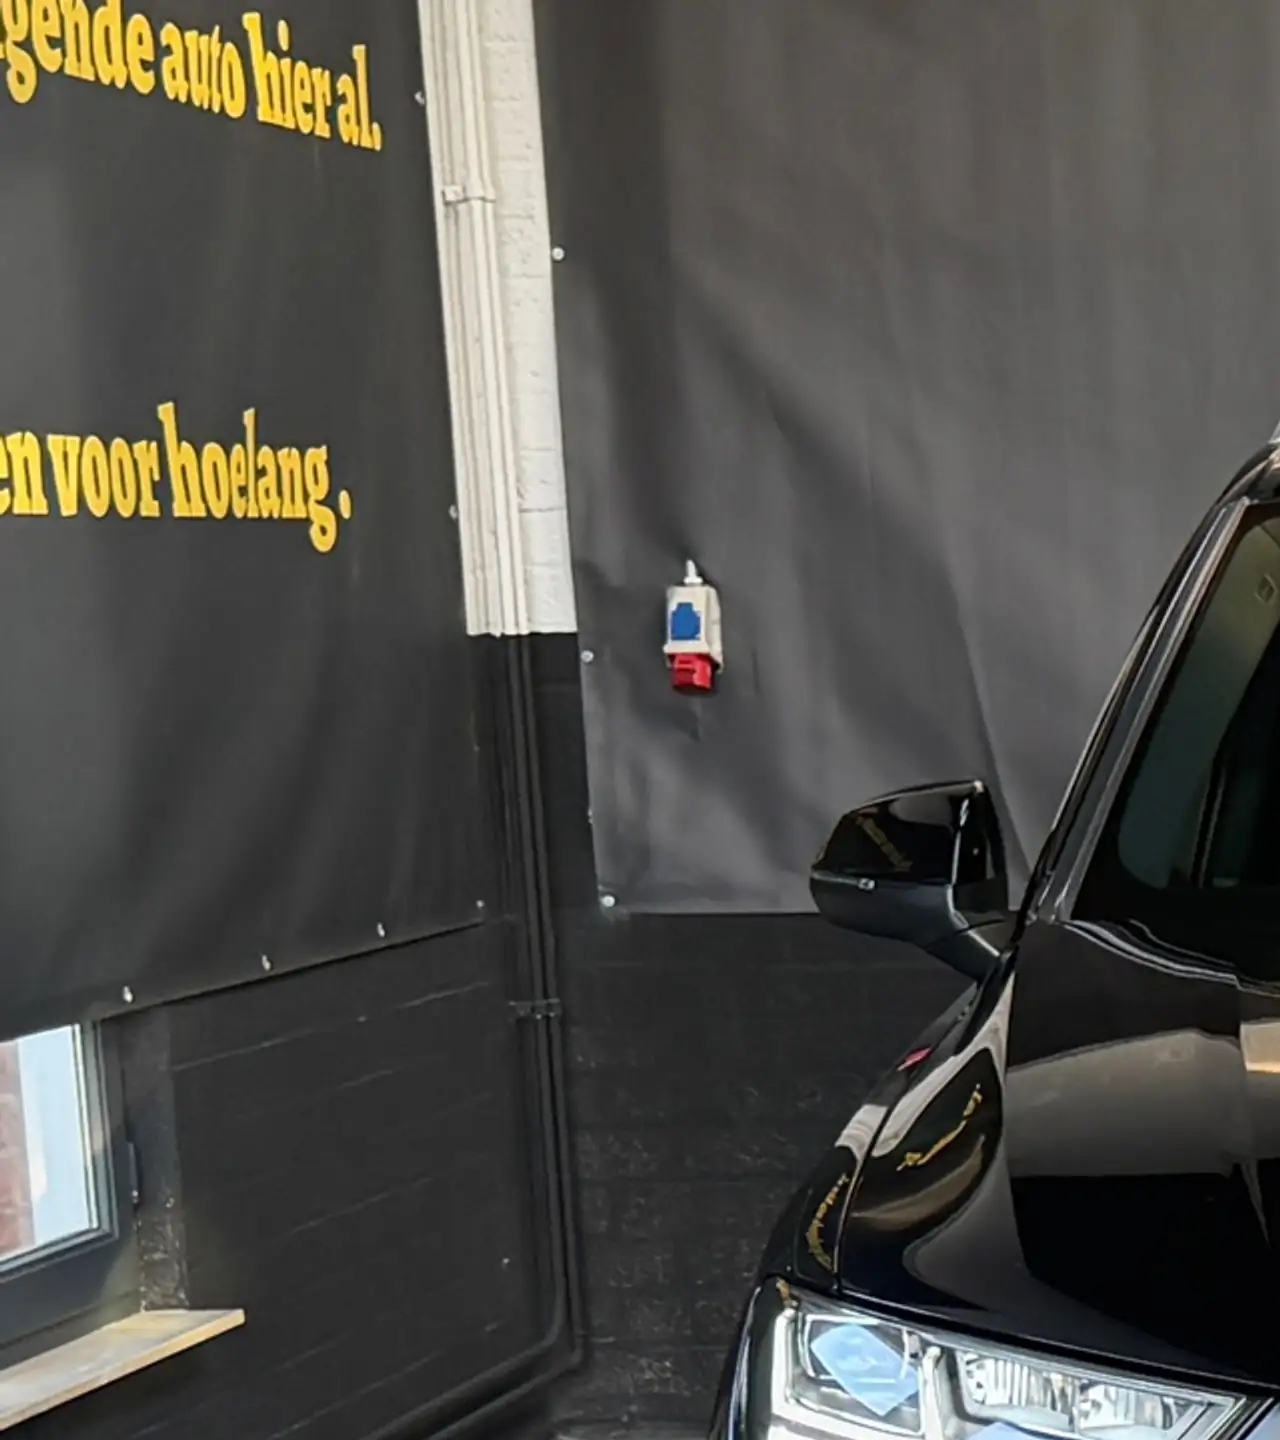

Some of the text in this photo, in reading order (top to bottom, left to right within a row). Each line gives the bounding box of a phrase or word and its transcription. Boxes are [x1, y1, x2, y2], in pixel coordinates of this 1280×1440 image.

[0, 0, 382, 152] gende auto hier al.
[46, 433, 161, 518] voor
[157, 402, 352, 553] hoelang.
